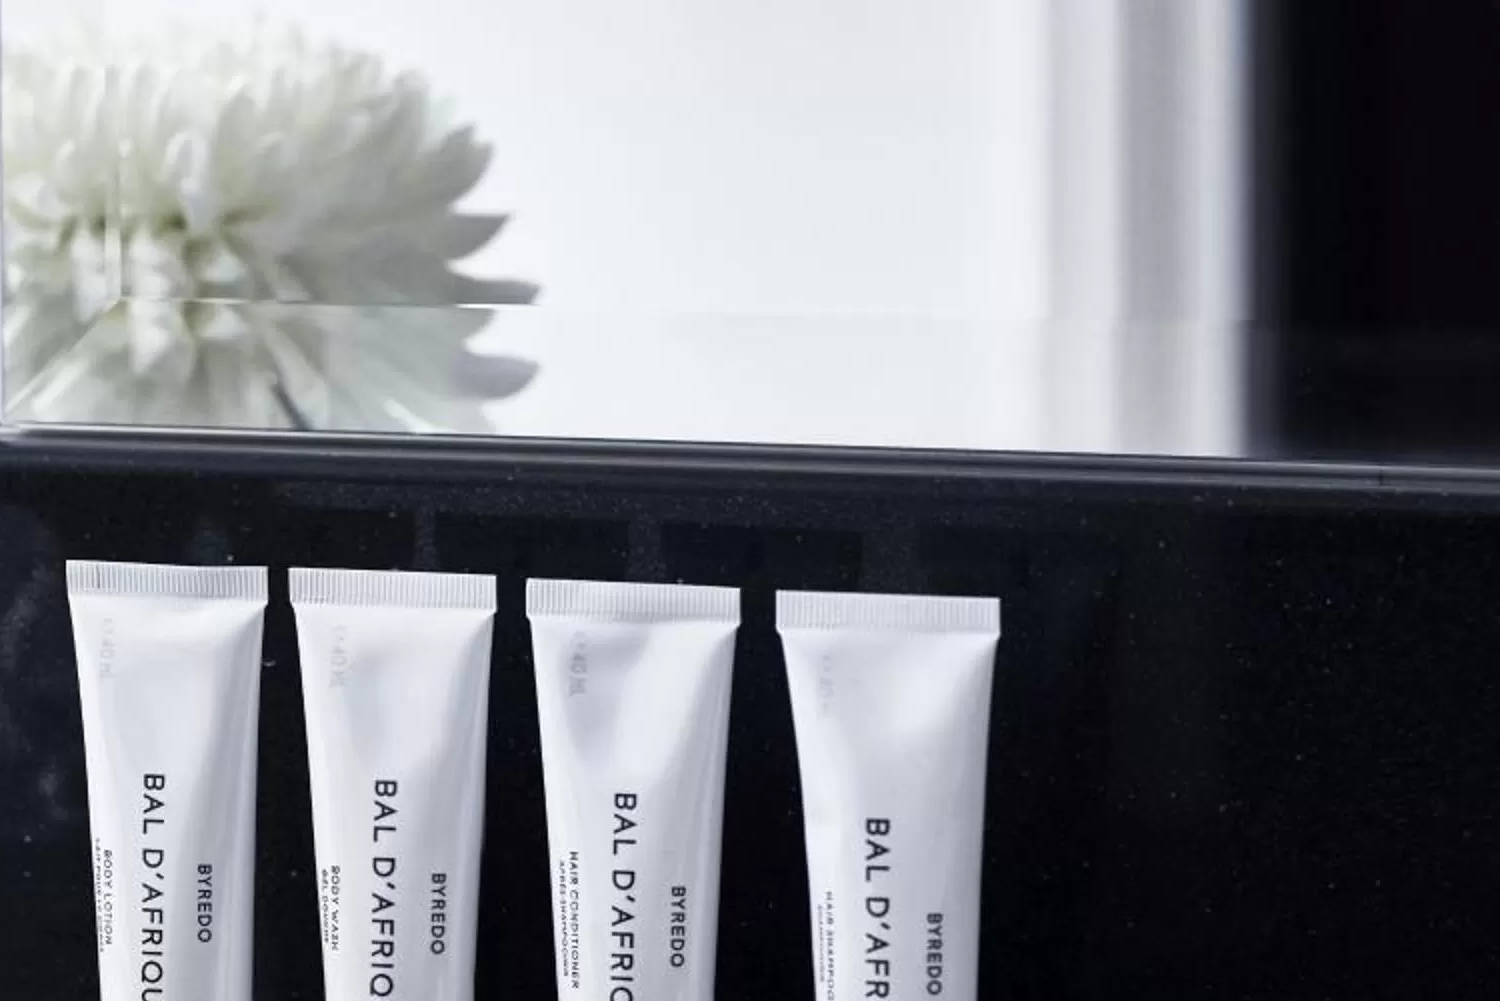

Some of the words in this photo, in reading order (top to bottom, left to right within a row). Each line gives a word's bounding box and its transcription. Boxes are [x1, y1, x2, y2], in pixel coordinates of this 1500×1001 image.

[143, 774, 165, 834] BAL
[374, 780, 397, 842] BAL
[613, 793, 637, 855] BAL
[103, 849, 113, 889] BODY
[569, 851, 579, 885] HAIR
[866, 819, 890, 881] BAL
[198, 864, 212, 942] BYREDO
[331, 865, 341, 905] BODY
[430, 874, 446, 954] BYREDO
[103, 892, 114, 945] LOTION
[331, 909, 339, 951] WASH
[570, 889, 580, 989] CONDITIONER
[670, 886, 686, 967] BYREDO
[926, 913, 943, 995] BYREDO
